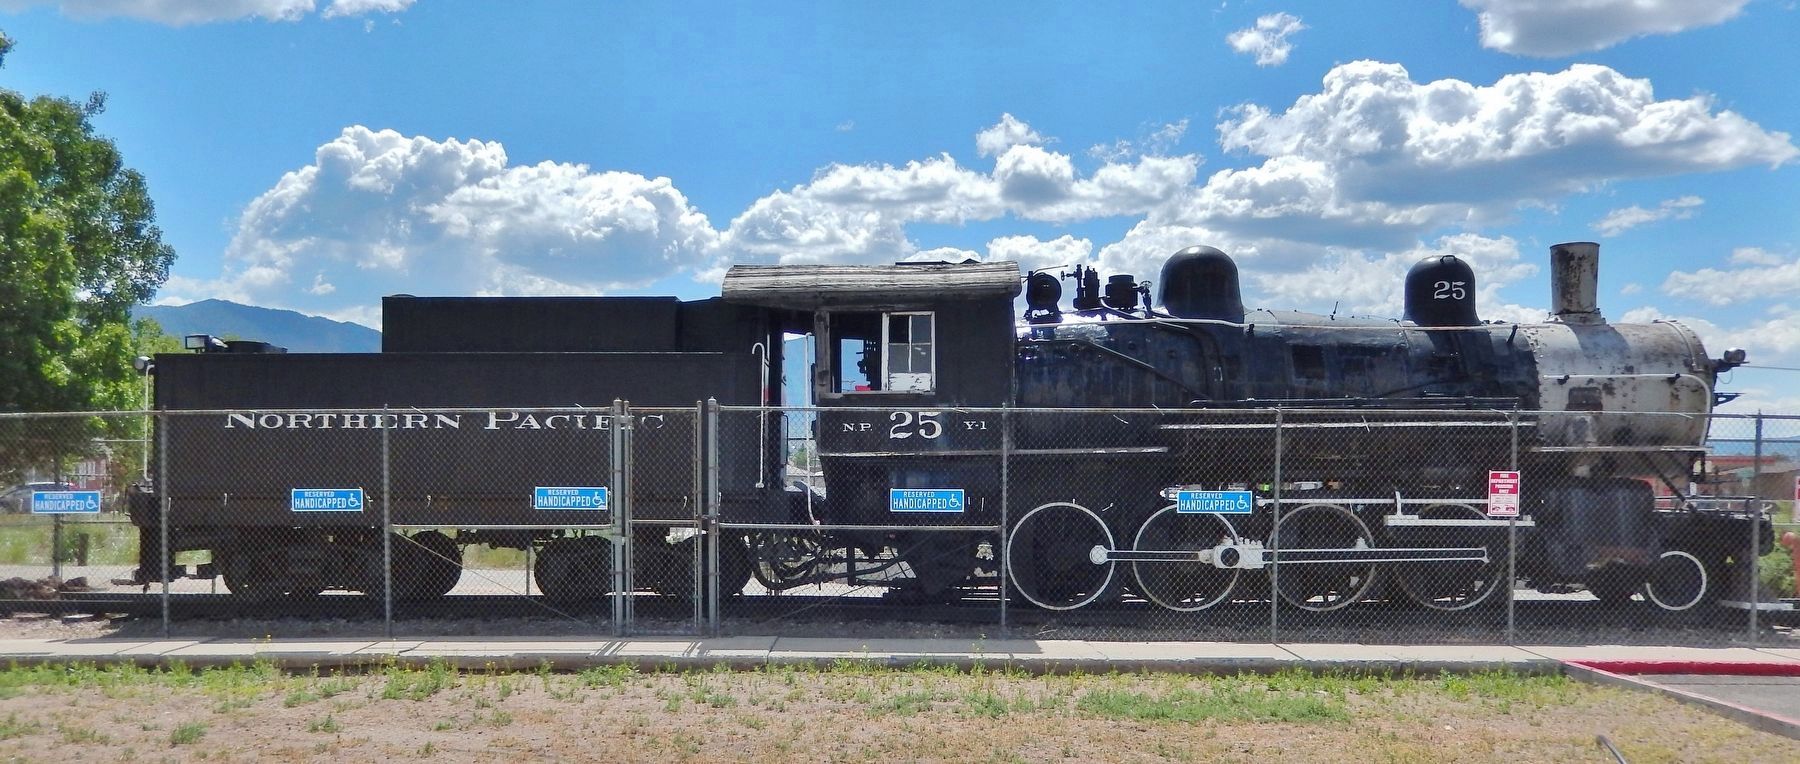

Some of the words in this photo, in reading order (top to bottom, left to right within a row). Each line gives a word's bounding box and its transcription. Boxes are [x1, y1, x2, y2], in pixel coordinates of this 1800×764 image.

[1434, 280, 1466, 300] 25
[224, 411, 462, 429] NORTHERN
[484, 411, 664, 430] PACIFC
[889, 411, 943, 439] 25
[963, 420, 987, 430] Y-1
[537, 495, 591, 507] HANDICAPPED
[1190, 492, 1223, 500] RESERVED
[35, 500, 85, 511] HANDICAPPED
[294, 497, 347, 509] HANDICAPPED
[893, 498, 947, 509] HANDICAPPED
[1180, 500, 1235, 511] HANDICAPPED
